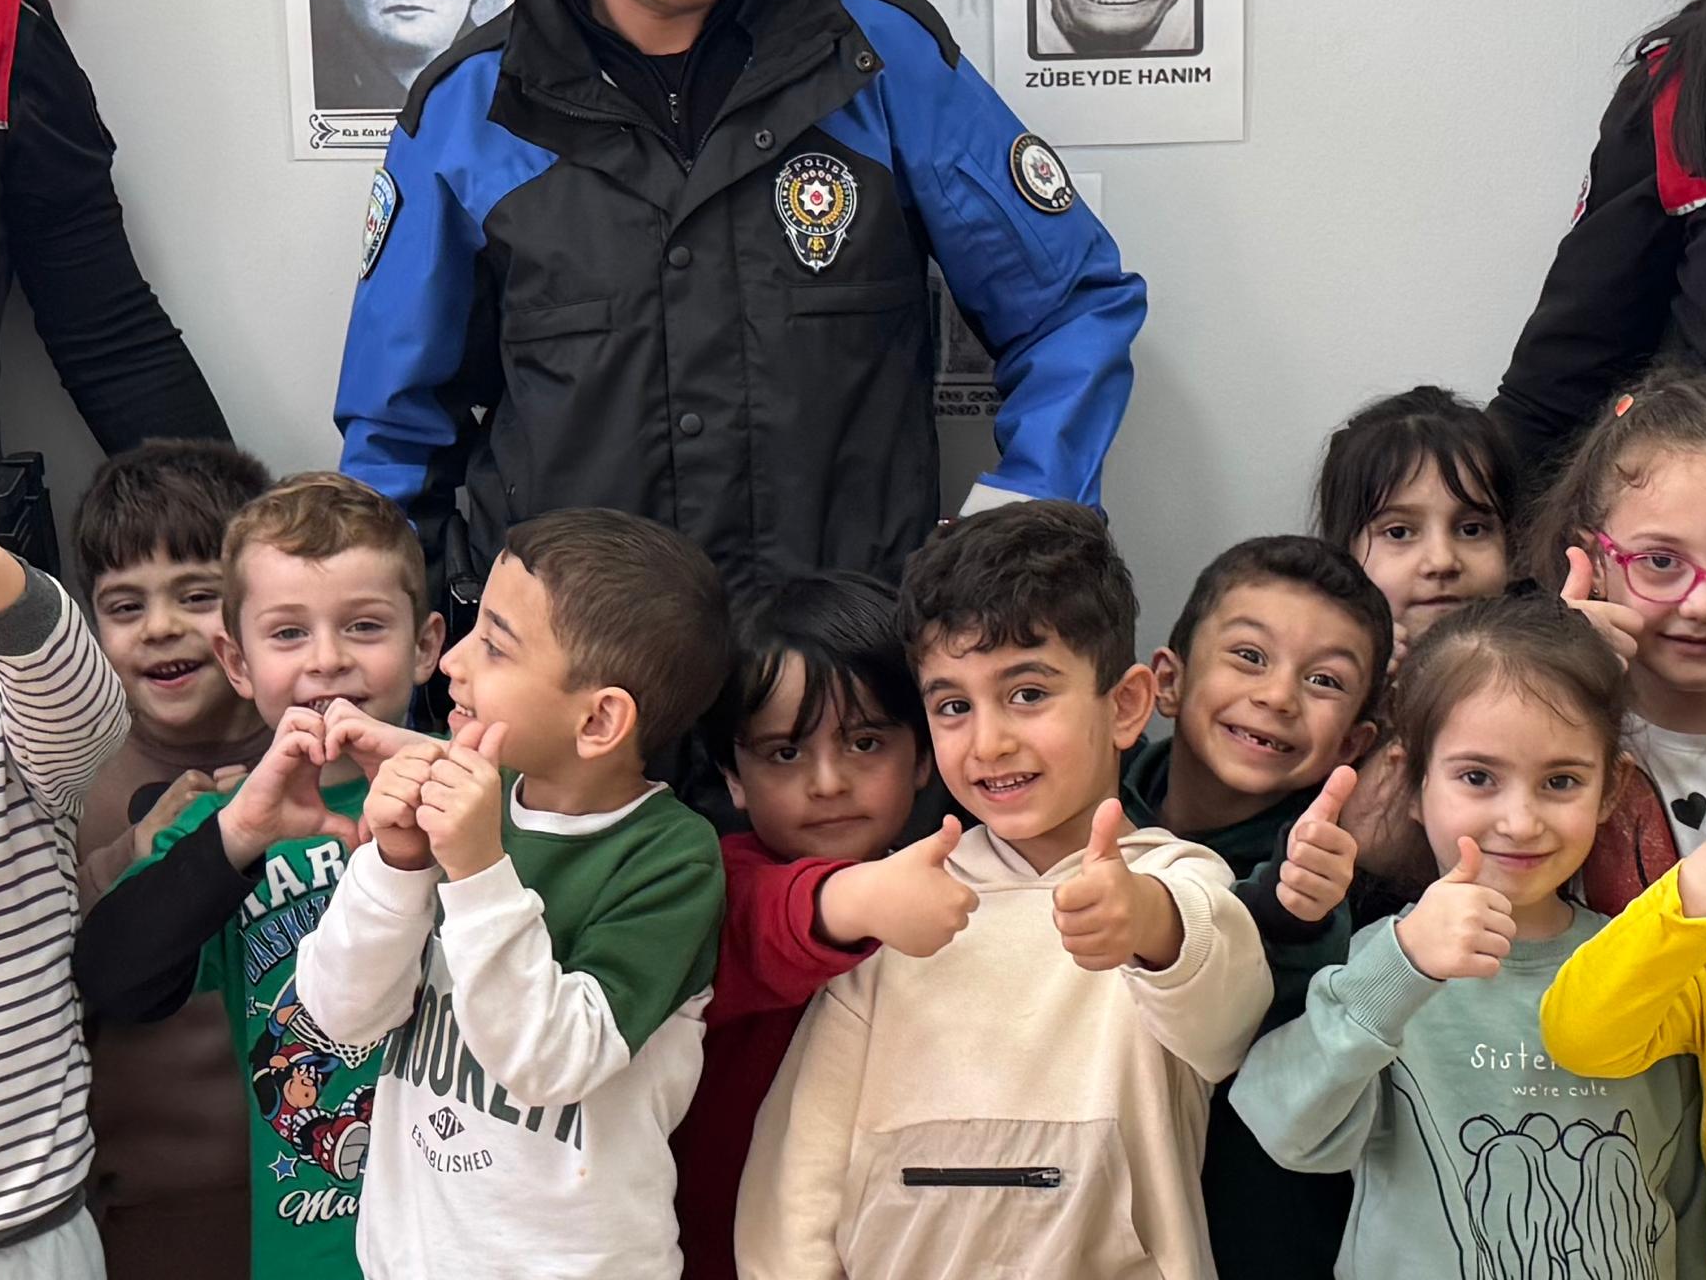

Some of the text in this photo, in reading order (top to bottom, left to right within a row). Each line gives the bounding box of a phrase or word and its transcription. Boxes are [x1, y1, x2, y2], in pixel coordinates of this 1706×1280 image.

[1025, 66, 1212, 88] ZÜBEYDE HANIM
[1511, 1080, 1610, 1098] we're cute
